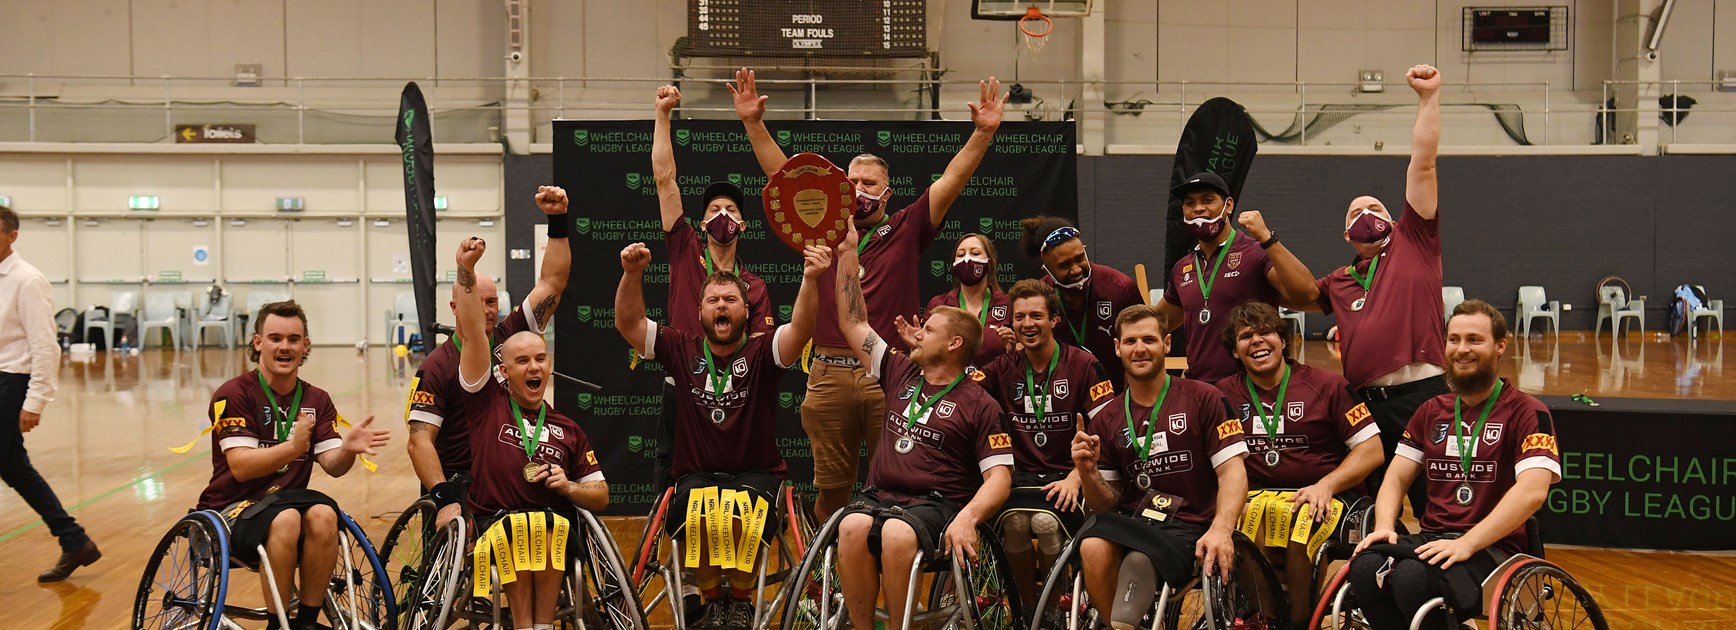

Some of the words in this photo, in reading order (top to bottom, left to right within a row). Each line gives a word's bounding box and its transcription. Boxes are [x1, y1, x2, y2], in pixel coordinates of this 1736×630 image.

[883, 8, 890, 16] 11
[792, 14, 823, 24] PERIOD
[883, 16, 890, 24] 12
[781, 28, 805, 38] TEAM
[807, 28, 834, 38] FOULS
[883, 24, 890, 33] 13
[883, 32, 890, 41] 14
[883, 41, 890, 49] 15
[590, 132, 653, 142] WHEELCHAI
[691, 132, 750, 141] WHEELCHA
[792, 133, 861, 142] WHEELCHAIR
[892, 133, 961, 143] WHEELCHAIR
[995, 134, 1063, 143] WHEELCHAIR
[590, 143, 623, 153] RUGBY
[626, 143, 651, 153] LEAG
[691, 143, 725, 152] RUGBY
[727, 143, 752, 153] LEAG
[792, 144, 825, 153] RUGBY
[828, 144, 865, 153] LEAGUE
[892, 144, 925, 154] RUGBY
[995, 145, 1027, 154] RUGBY
[1030, 145, 1067, 154] LEAGUE
[981, 187, 1018, 197] LEAGUE
[592, 220, 662, 230] WHEELCHAIR
[592, 231, 625, 241] RUGBY
[627, 231, 665, 241] LEAGUE
[745, 263, 802, 273] WHEELCHA
[644, 274, 670, 284] RUGB
[780, 274, 802, 284] LEAG
[593, 395, 662, 405] WHEELCHAIR
[593, 406, 627, 416] RUGBY
[780, 448, 813, 458] LEAGU
[629, 494, 655, 504] LEAG
[690, 500, 699, 513] NRL
[723, 500, 731, 514] NRL
[742, 501, 750, 515] NRL
[1547, 488, 1612, 515] GBY
[1625, 491, 1736, 521] LEAGU
[755, 507, 764, 520] NRL
[534, 514, 543, 564] WHEELCHAIR
[709, 512, 719, 559] WHEELCHAIR
[722, 513, 732, 562] WHEELCHAIR
[744, 520, 761, 565] WHEELCHAIR
[493, 526, 511, 576] WHEELCHAIR
